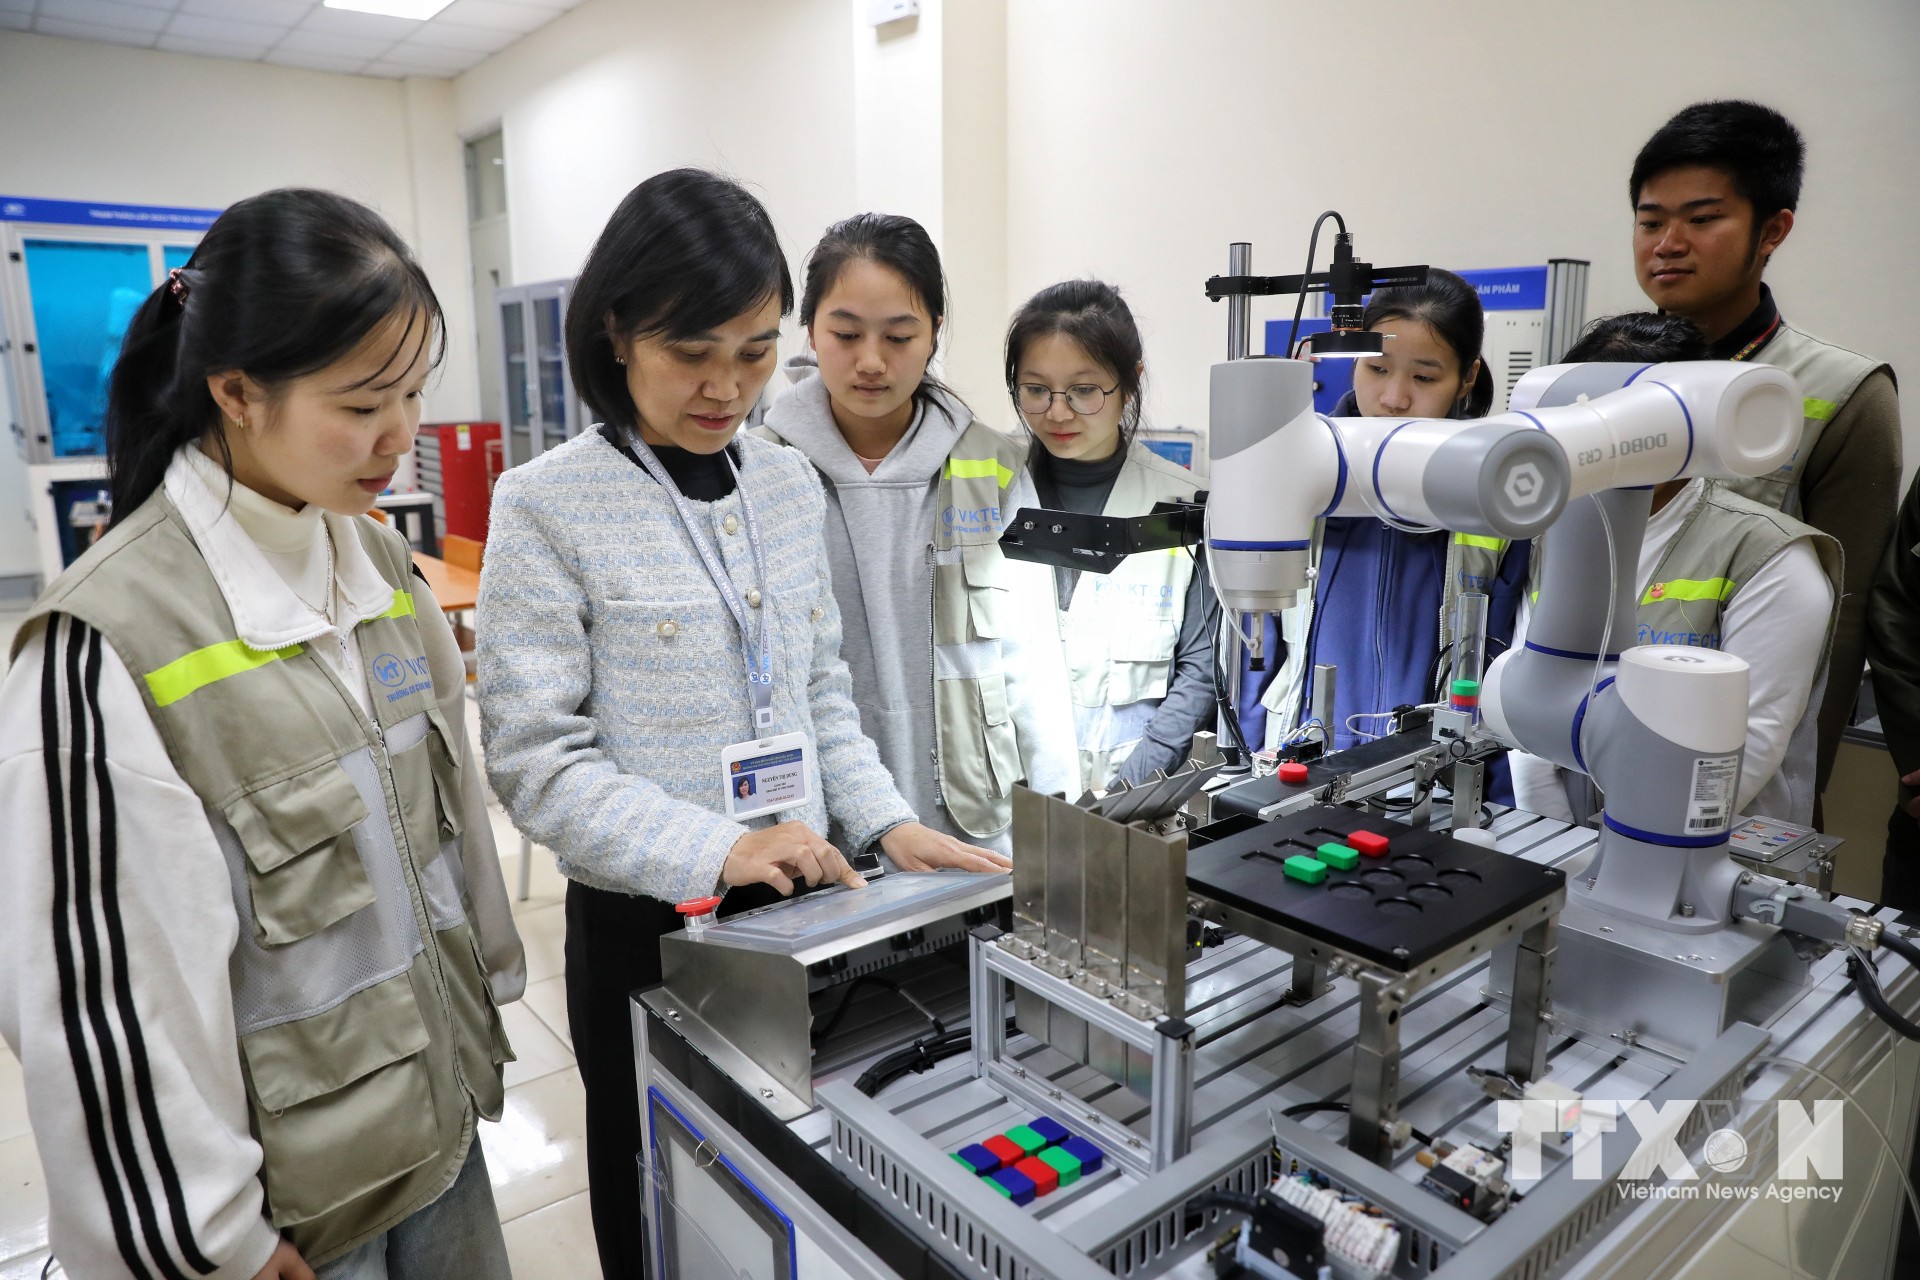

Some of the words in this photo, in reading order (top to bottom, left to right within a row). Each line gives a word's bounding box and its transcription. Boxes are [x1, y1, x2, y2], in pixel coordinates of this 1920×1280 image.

[1608, 432, 1668, 460] DOBOT
[643, 454, 654, 463] IN
[1577, 447, 1603, 467] CR3
[649, 462, 685, 507] TECHNOLOGY
[681, 507, 690, 518] OF
[688, 518, 709, 552] COLLEGE
[705, 551, 723, 578] KOREA
[720, 581, 735, 600] NAM
[731, 601, 743, 617] VIET
[1650, 629, 1720, 649] VKTECH
